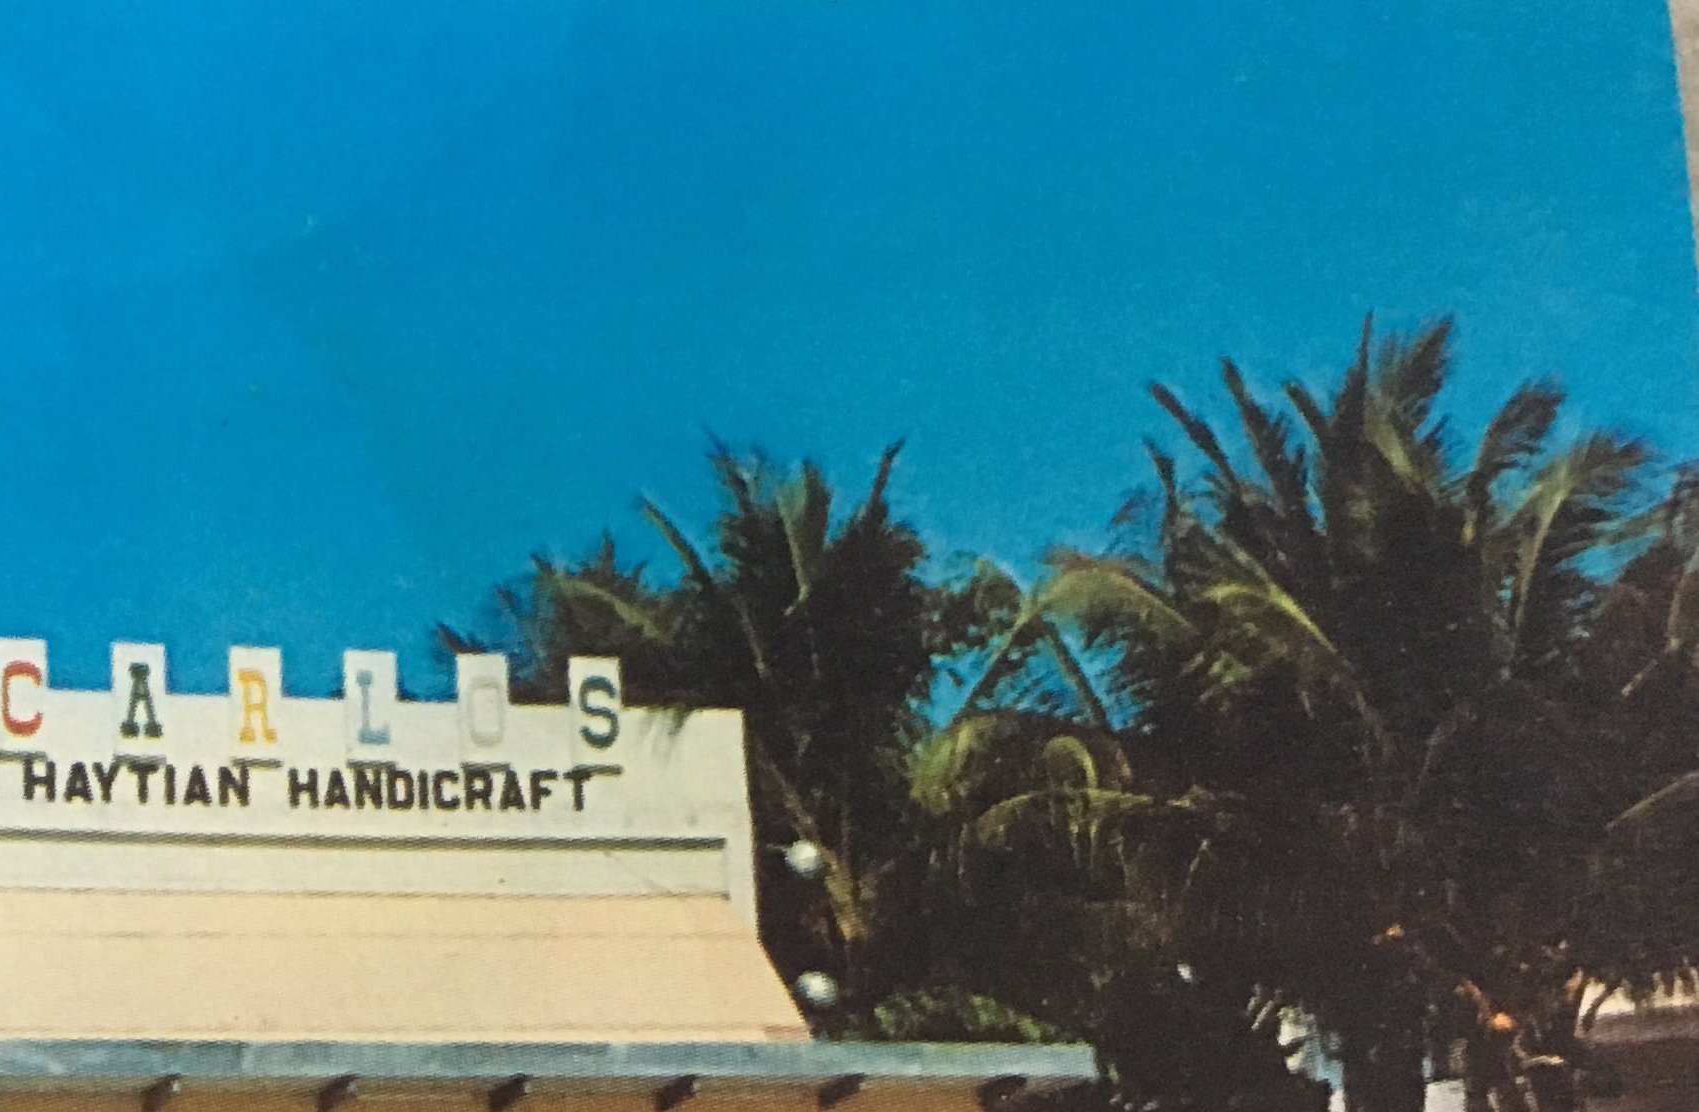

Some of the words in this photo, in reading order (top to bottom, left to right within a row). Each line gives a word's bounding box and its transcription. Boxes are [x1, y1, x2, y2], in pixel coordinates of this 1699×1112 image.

[0, 659, 622, 750] CARLOS
[21, 757, 252, 806] HAYTIAN
[286, 766, 595, 813] HANDICRAFT
